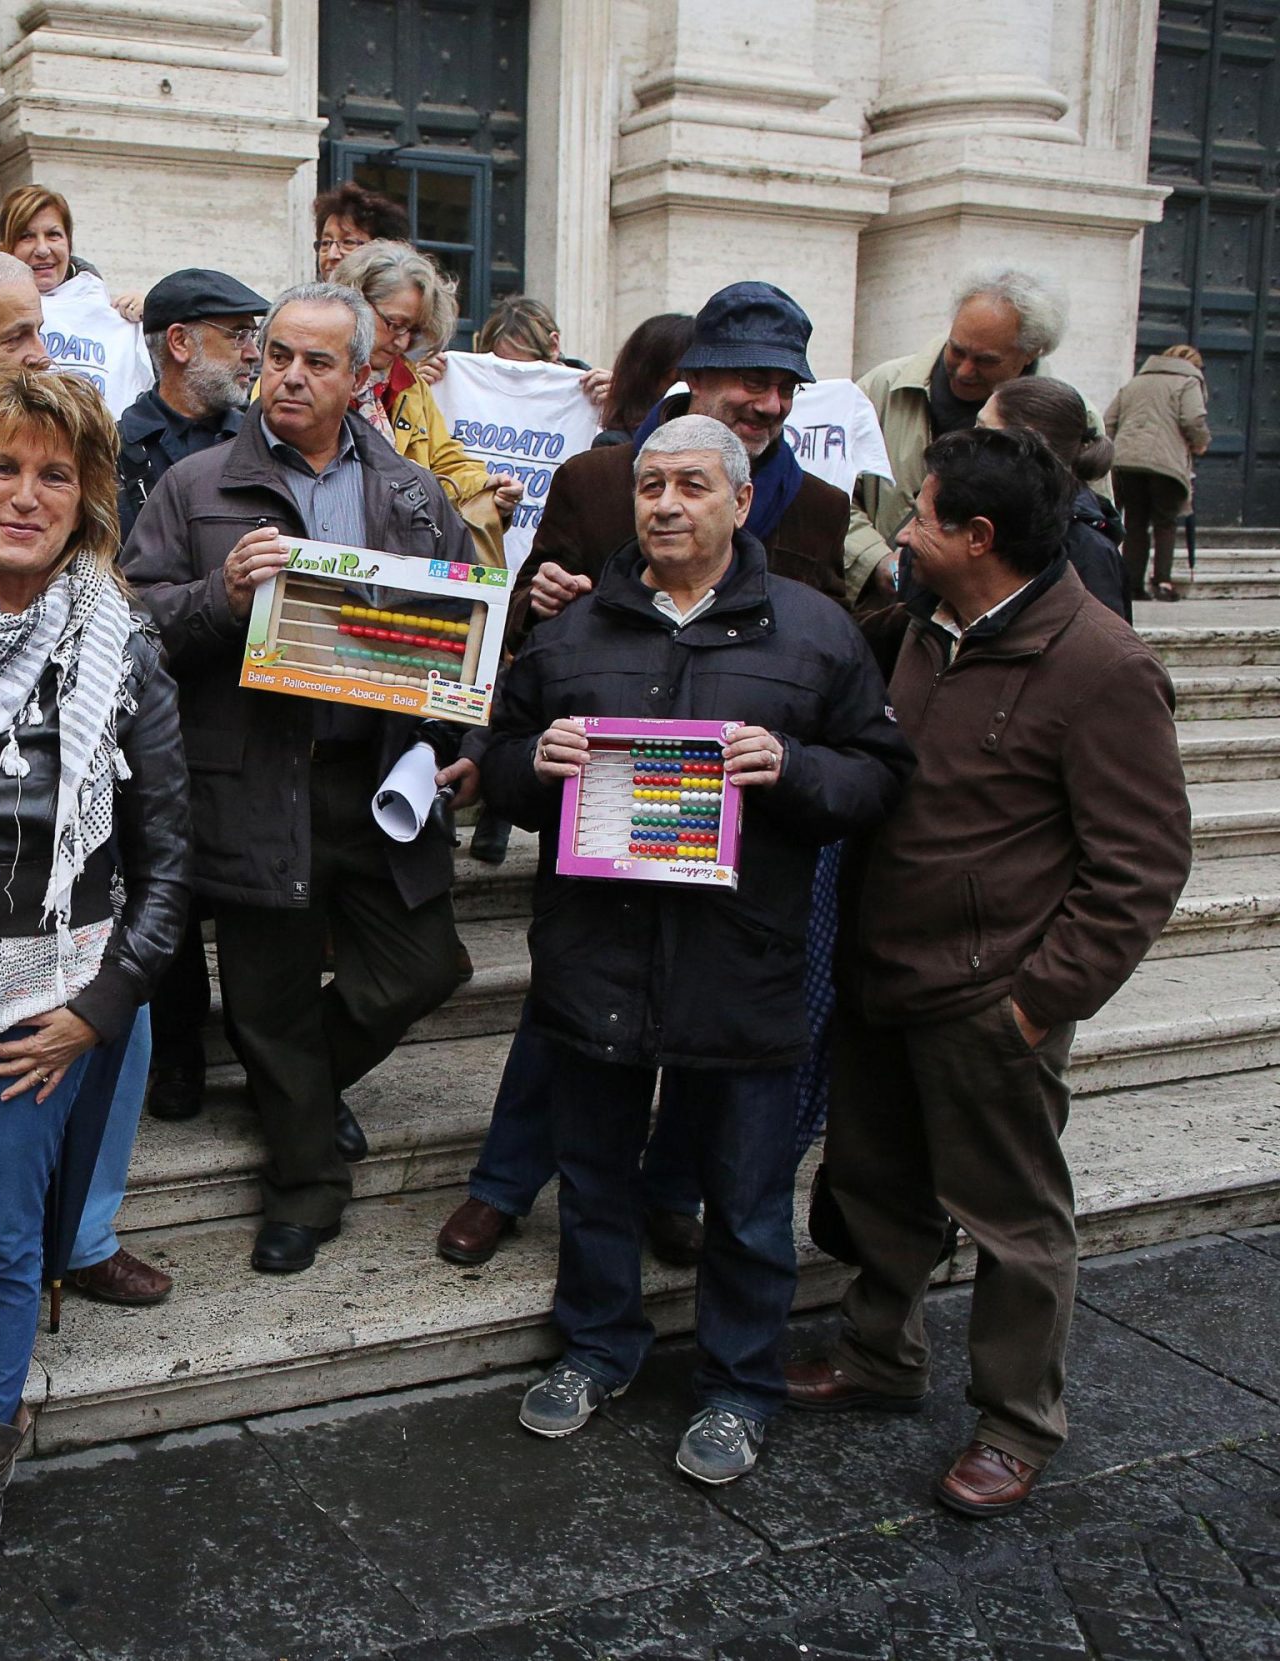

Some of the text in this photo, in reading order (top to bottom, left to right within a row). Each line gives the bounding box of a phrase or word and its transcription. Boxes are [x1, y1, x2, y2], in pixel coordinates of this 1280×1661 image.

[454, 419, 565, 459] ESODATO
[428, 569, 449, 578] ABC
[347, 688, 386, 702] Abacus
[669, 866, 713, 879] Eichhorn
